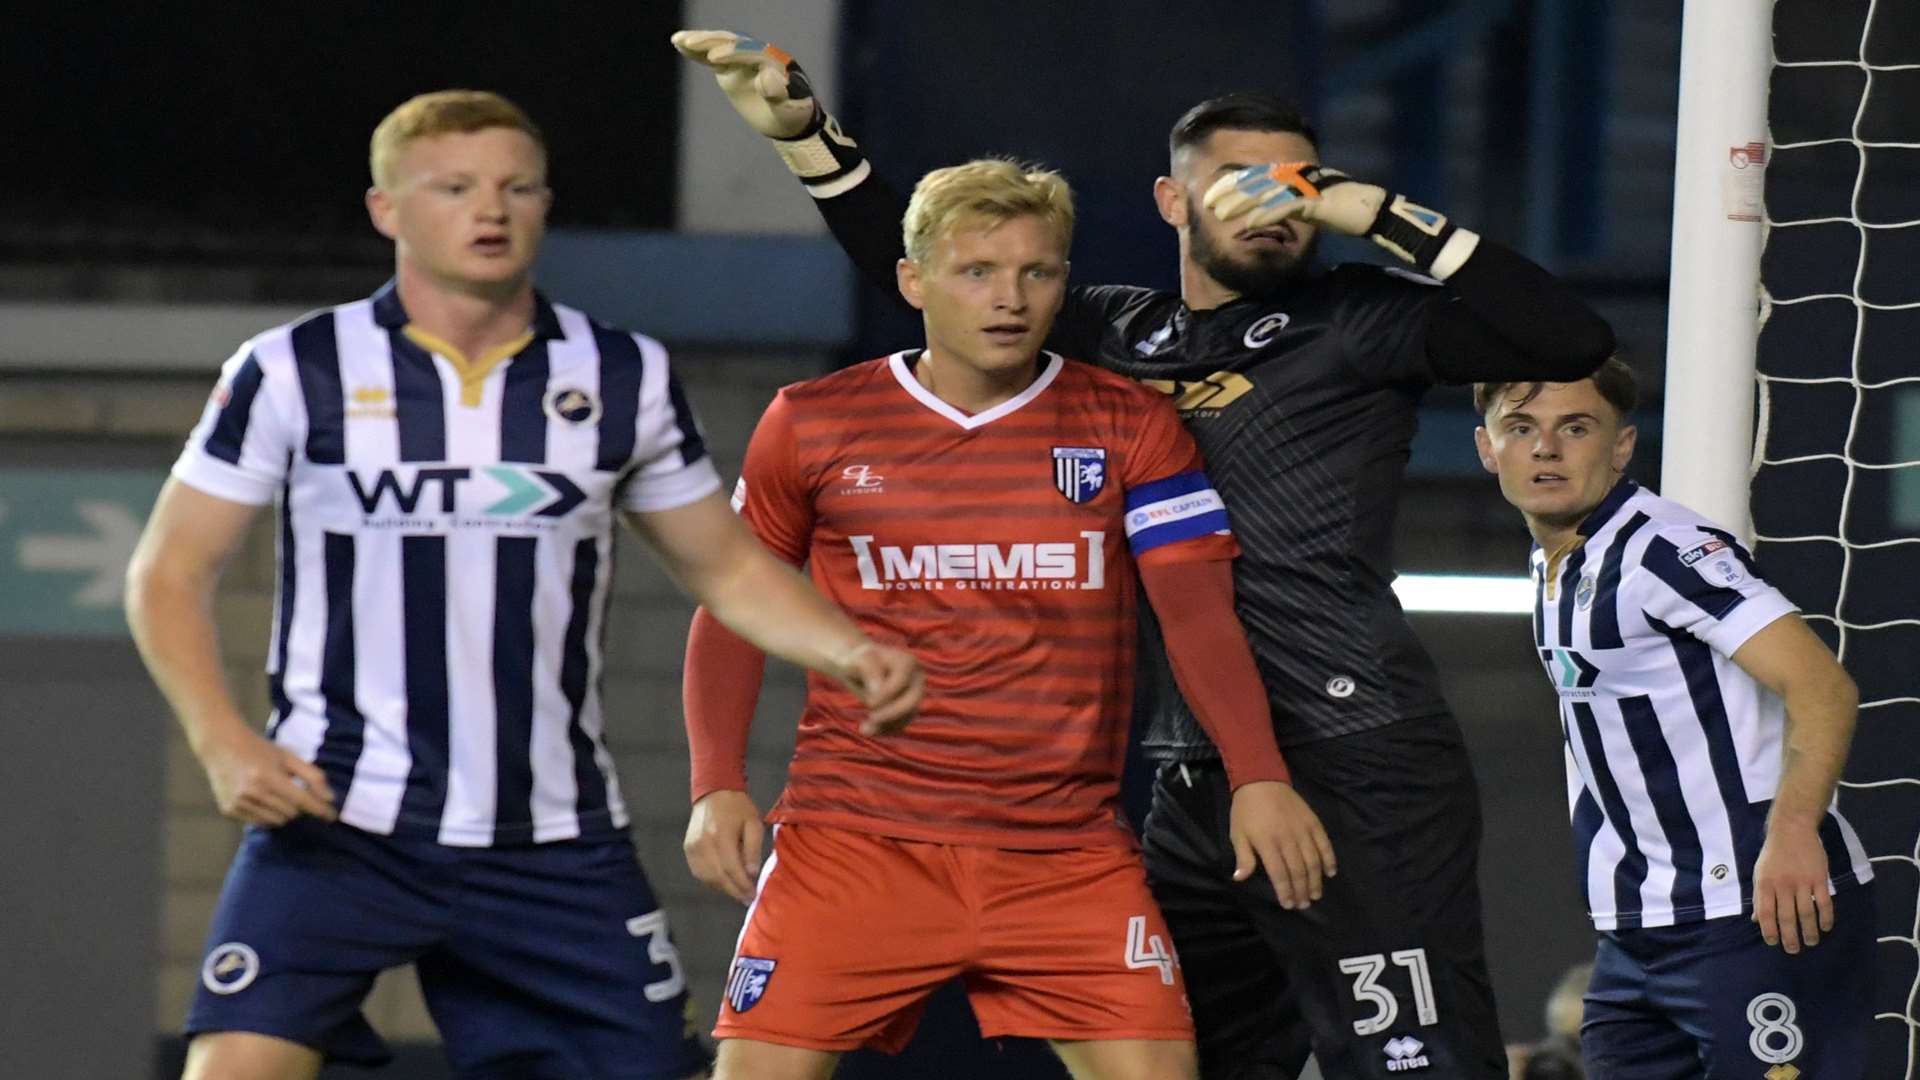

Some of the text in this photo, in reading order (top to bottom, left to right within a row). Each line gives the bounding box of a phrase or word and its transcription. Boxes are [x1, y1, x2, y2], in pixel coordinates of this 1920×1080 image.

[347, 468, 470, 514] WT
[885, 580, 1076, 591] POWER GENERATION
[625, 910, 686, 1003] 3
[1124, 915, 1175, 986] 4
[1338, 948, 1438, 1036] 31
[1746, 992, 1803, 1064] 8
